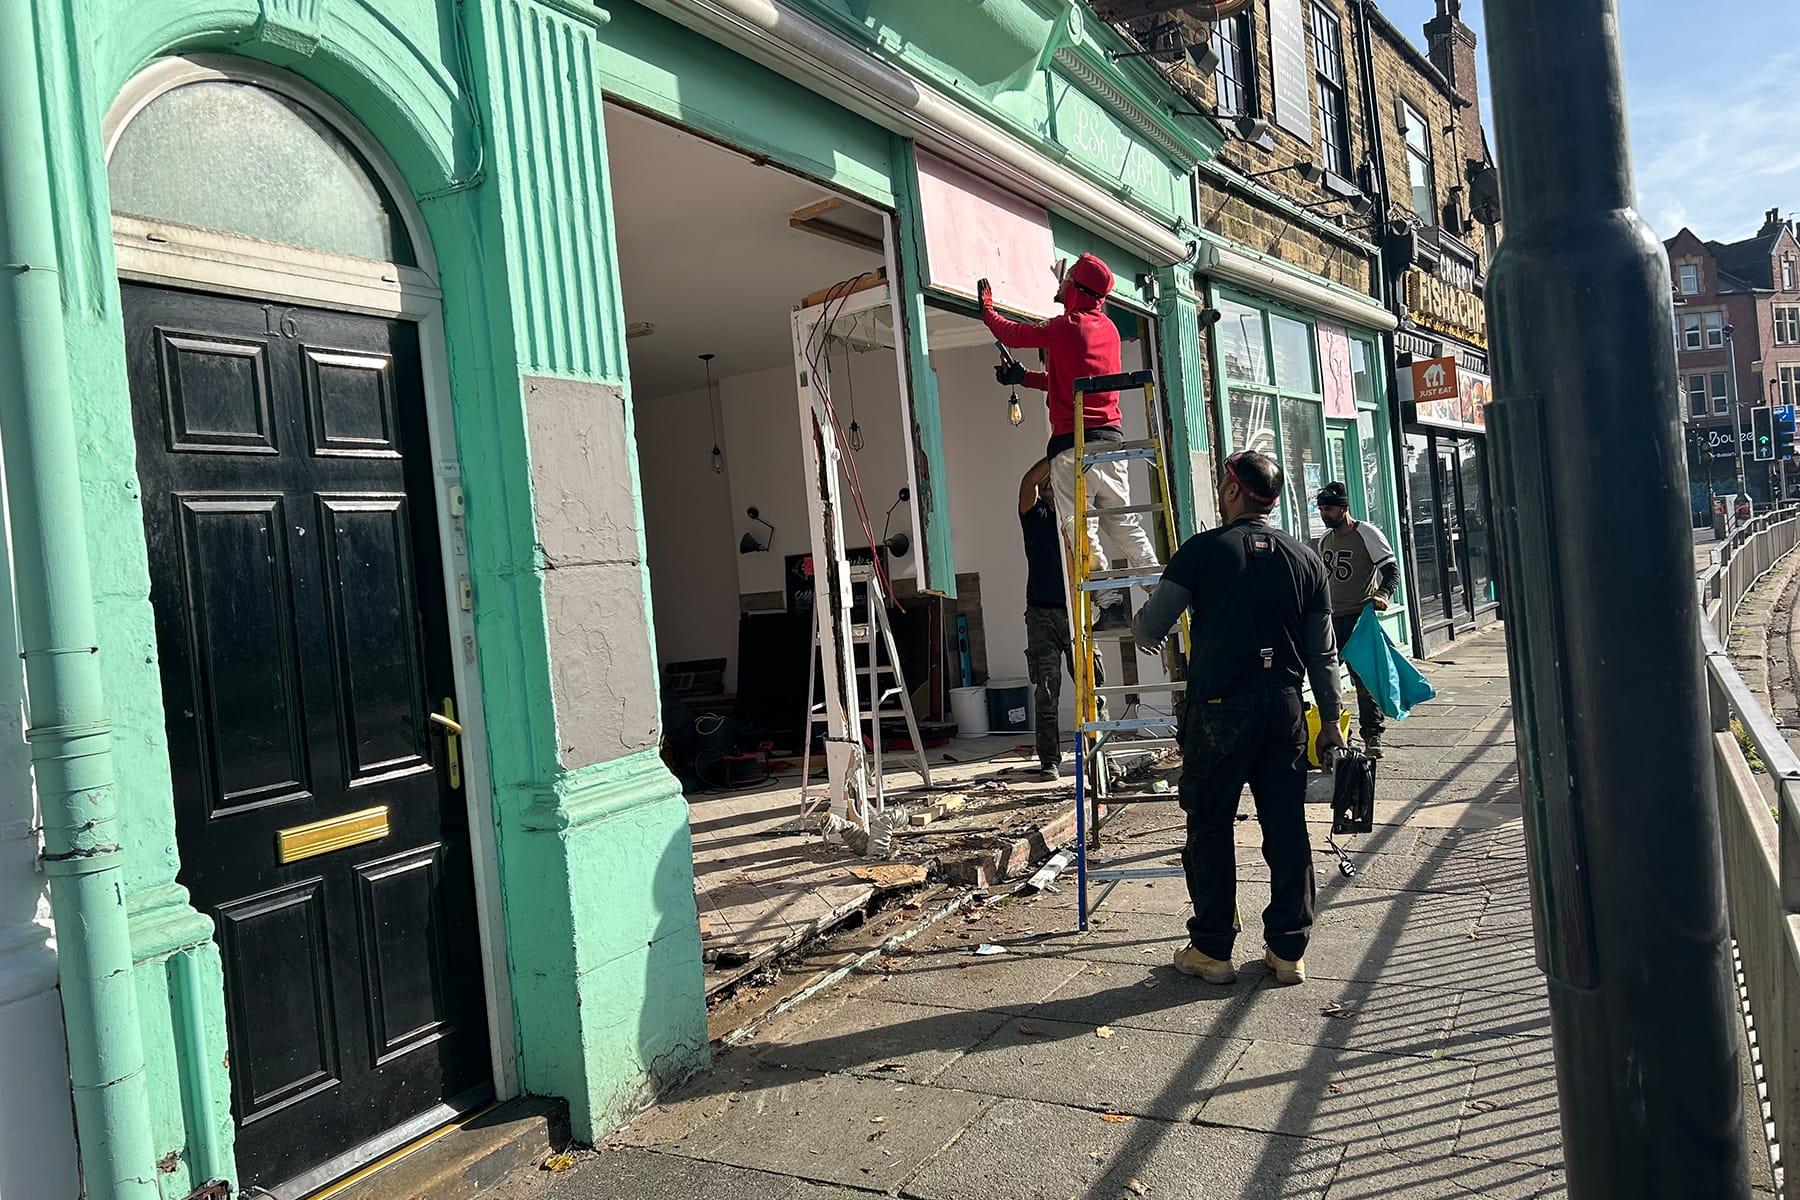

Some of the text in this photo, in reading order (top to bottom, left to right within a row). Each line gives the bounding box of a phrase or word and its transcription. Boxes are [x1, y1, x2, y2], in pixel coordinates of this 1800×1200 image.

[1440, 253, 1473, 292] CRISPY
[260, 304, 298, 339] 16
[1420, 386, 1453, 398] JUST EAT
